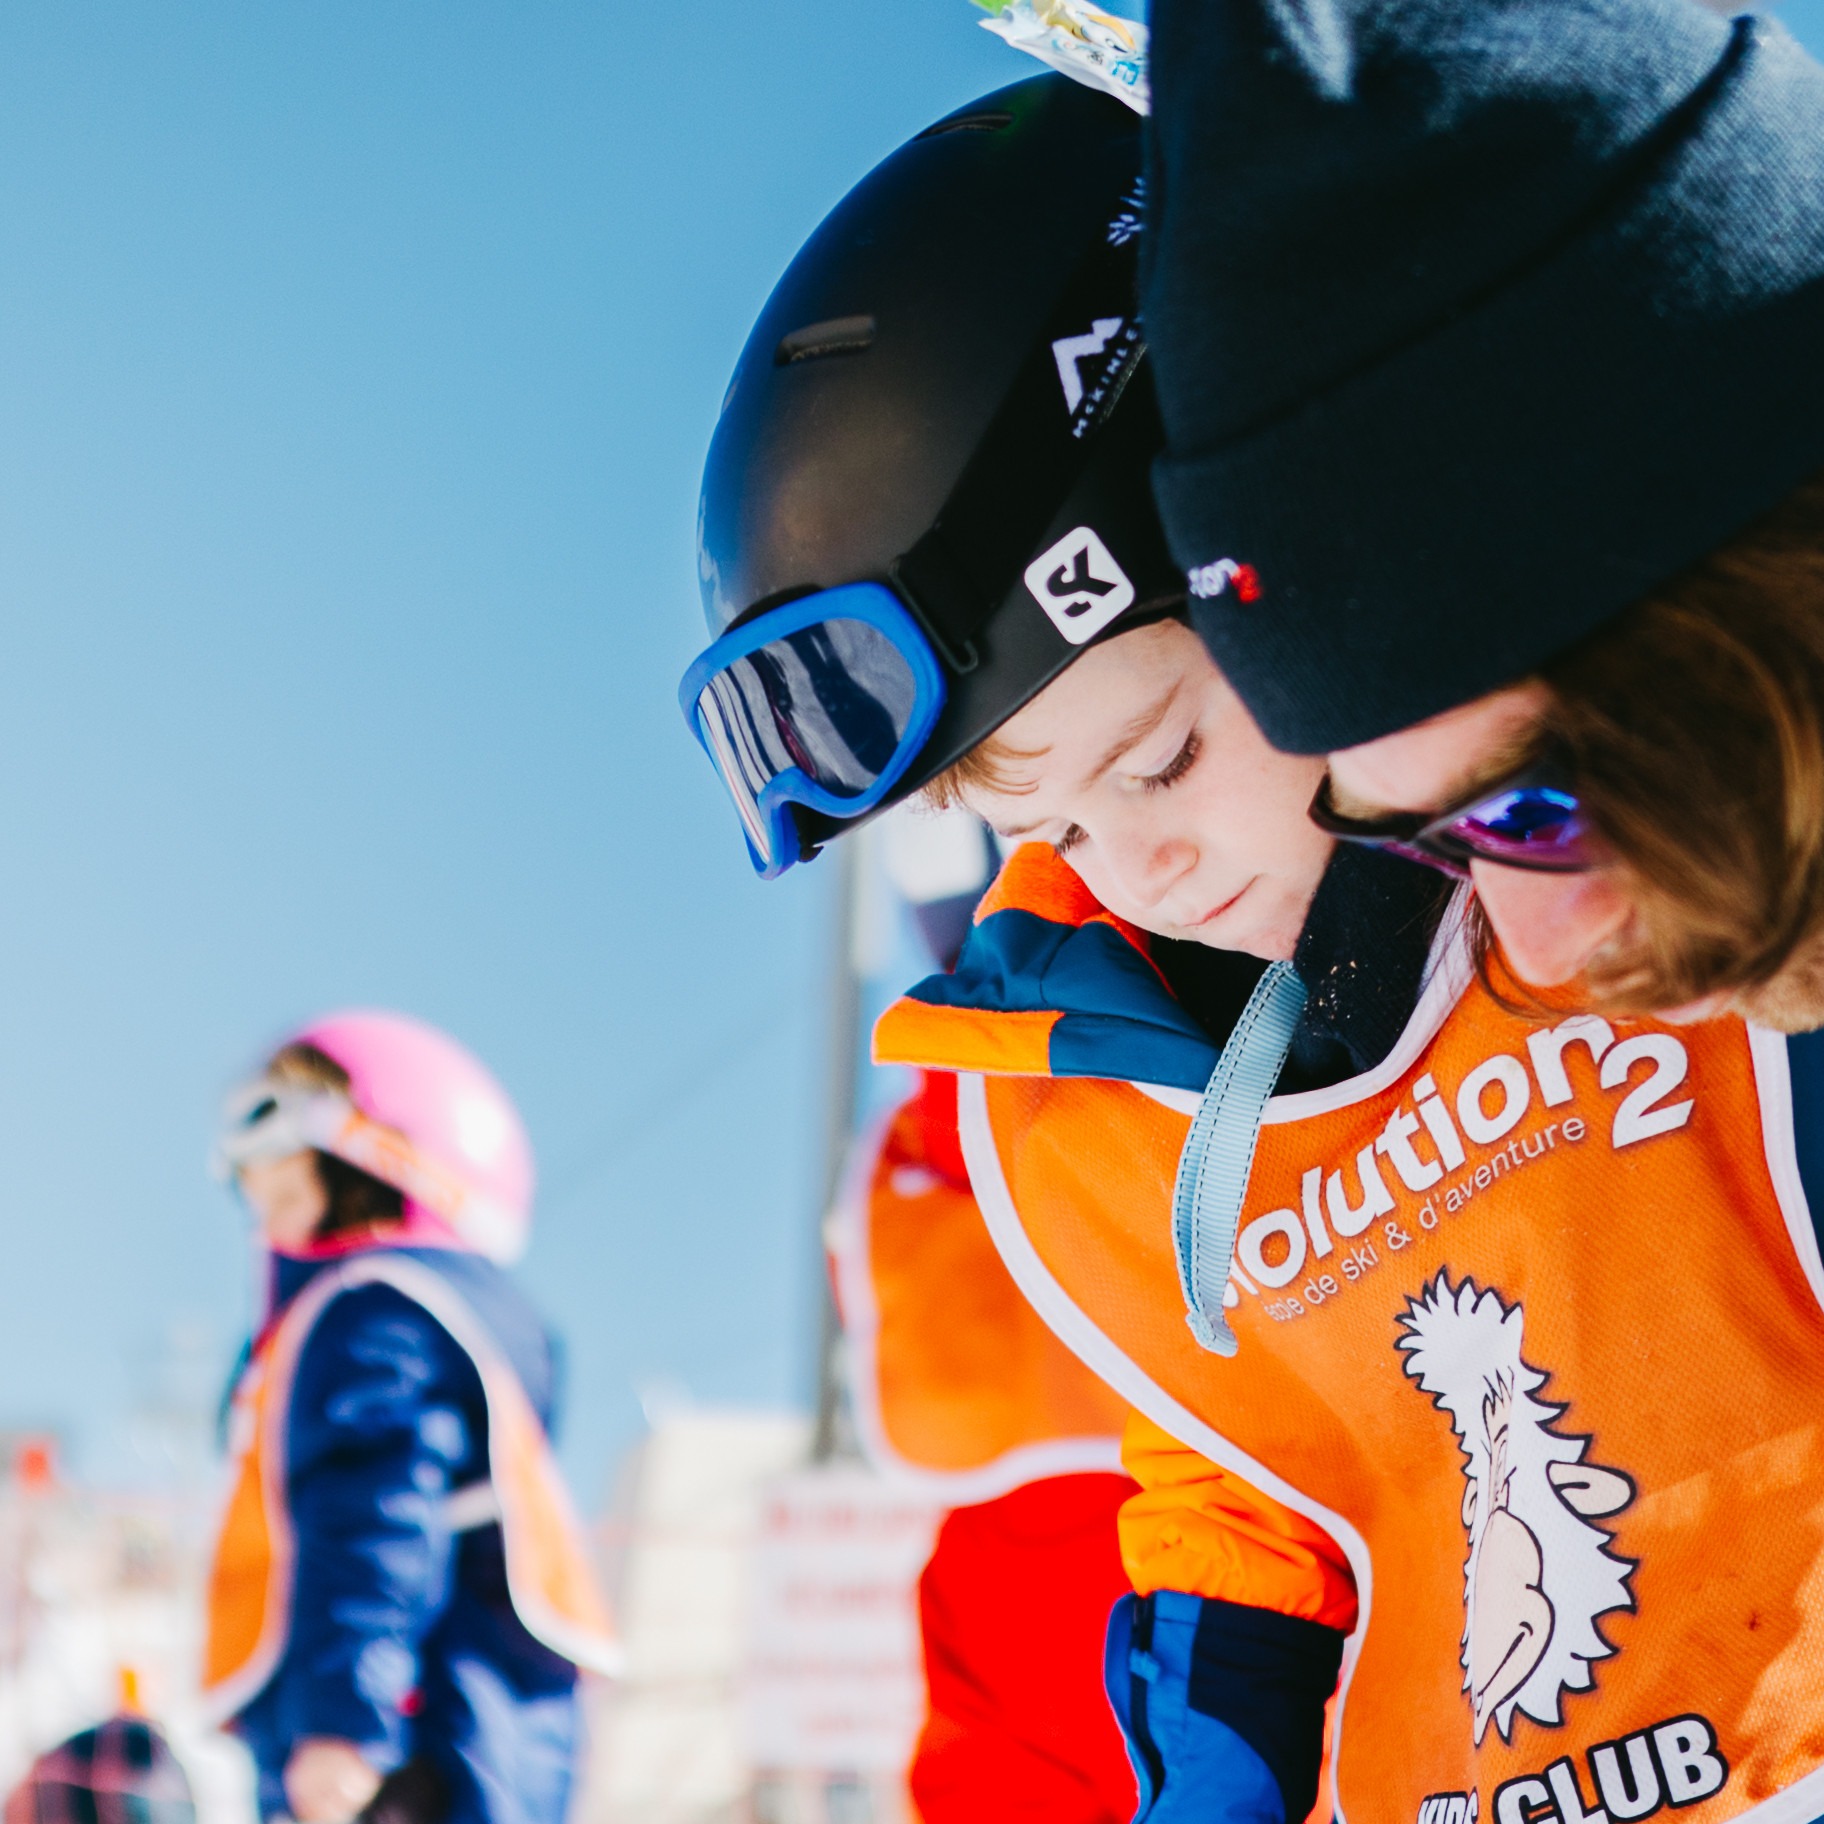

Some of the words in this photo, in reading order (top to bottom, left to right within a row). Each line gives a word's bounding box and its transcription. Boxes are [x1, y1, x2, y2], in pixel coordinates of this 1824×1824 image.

[1303, 1274, 1338, 1305] de
[1340, 1238, 1379, 1280] ski
[1384, 1221, 1412, 1250] &
[1418, 1117, 1586, 1230] d'aventure
